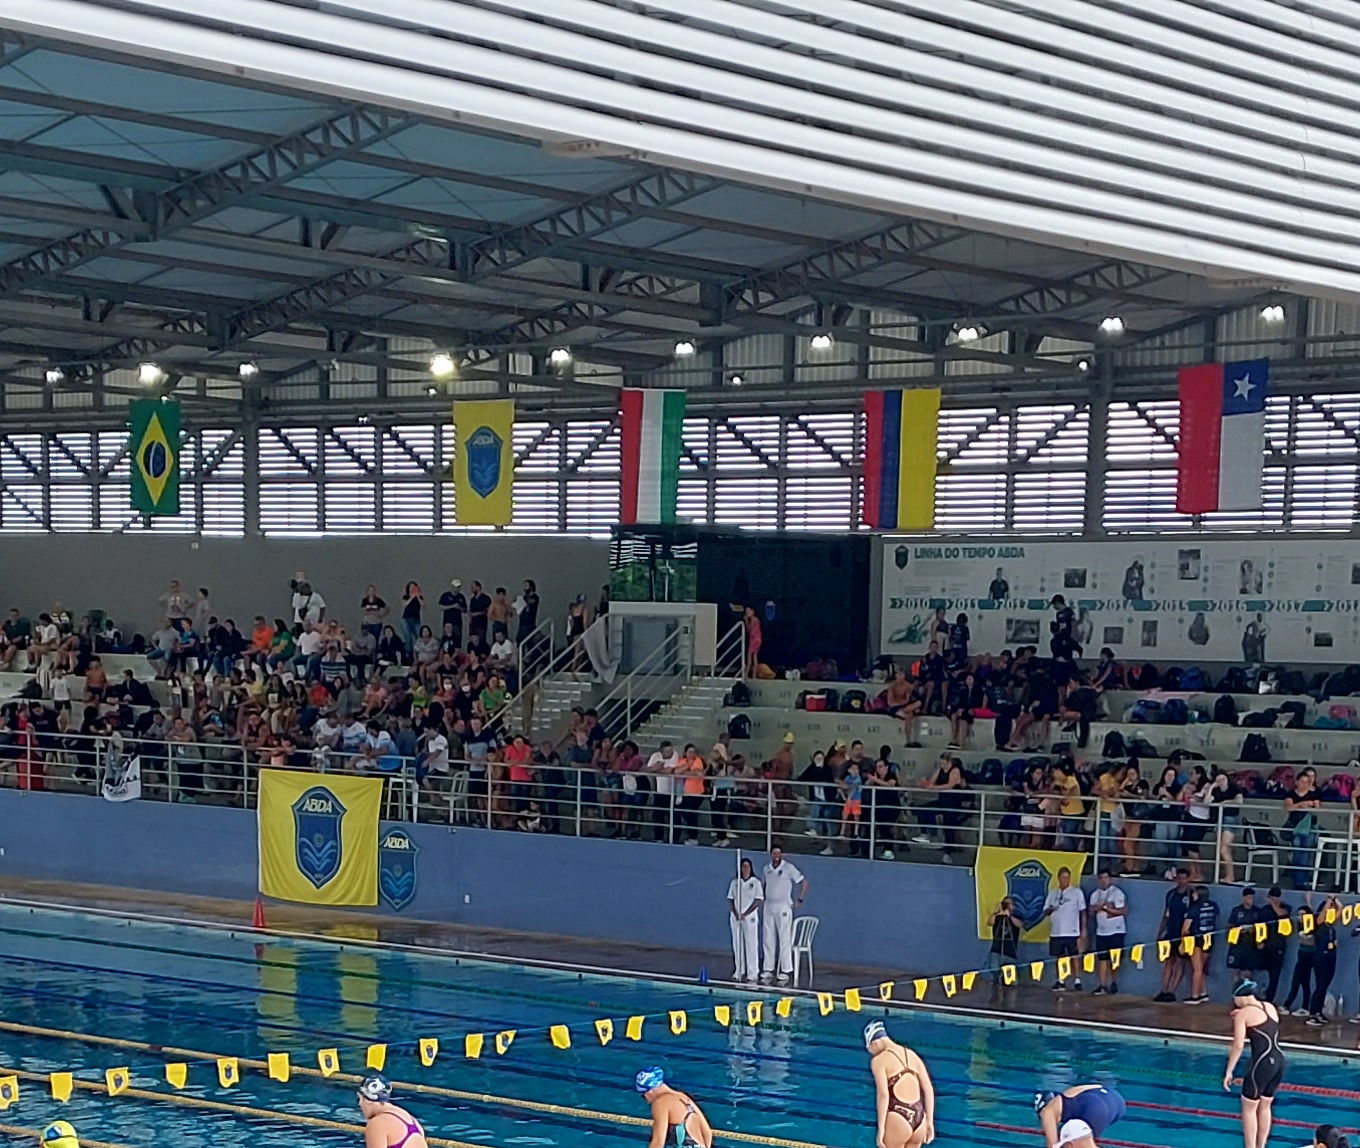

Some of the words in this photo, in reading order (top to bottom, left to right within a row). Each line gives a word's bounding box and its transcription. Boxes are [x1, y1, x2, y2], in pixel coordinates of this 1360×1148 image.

[914, 547, 943, 559] LINHA
[944, 547, 960, 559] DO
[961, 547, 996, 559] TEMPO
[997, 547, 1025, 559] ABDA
[902, 598, 930, 609] 2010
[302, 798, 333, 813] ABDA
[383, 837, 410, 850] ABDA
[1014, 867, 1040, 878] ABDA
